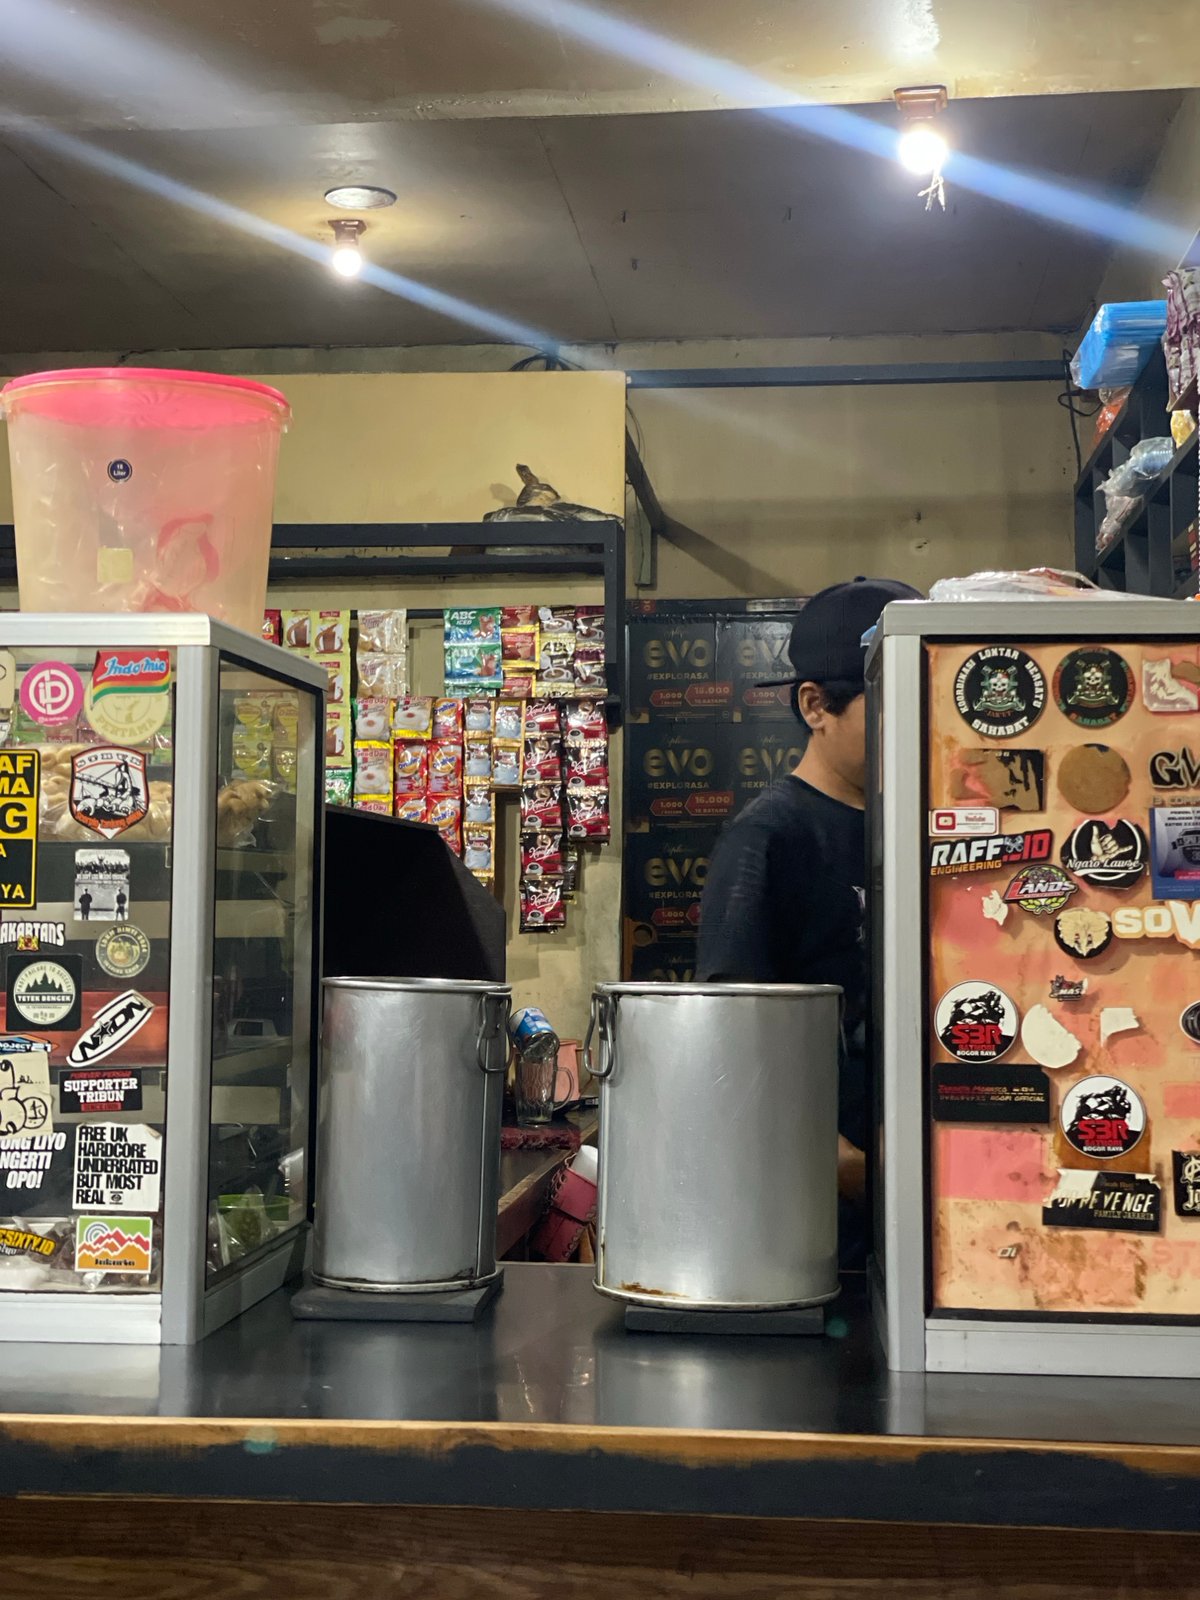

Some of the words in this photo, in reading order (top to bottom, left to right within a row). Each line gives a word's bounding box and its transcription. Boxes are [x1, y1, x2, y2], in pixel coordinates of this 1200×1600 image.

[450, 611, 477, 620] ABC
[978, 647, 1019, 660] LONTAR
[955, 659, 976, 714] KOORDINASI
[1024, 660, 1044, 708] BERSATU
[971, 716, 1029, 736] SAHABAT
[930, 860, 1002, 876] ENGINEERING
[64, 1077, 138, 1092] SUPPORTER
[77, 1090, 125, 1103] TRIBUN
[78, 1126, 106, 1141] FREE
[110, 1127, 129, 1142] UK
[78, 1142, 147, 1159] HARDCORE
[77, 1157, 158, 1175] UNDERRATED
[6, 1170, 44, 1189] OPO!
[76, 1174, 103, 1189] BUT
[105, 1175, 144, 1191] MOST
[75, 1189, 106, 1205] REAL
[1094, 1209, 1122, 1218] FAMILY
